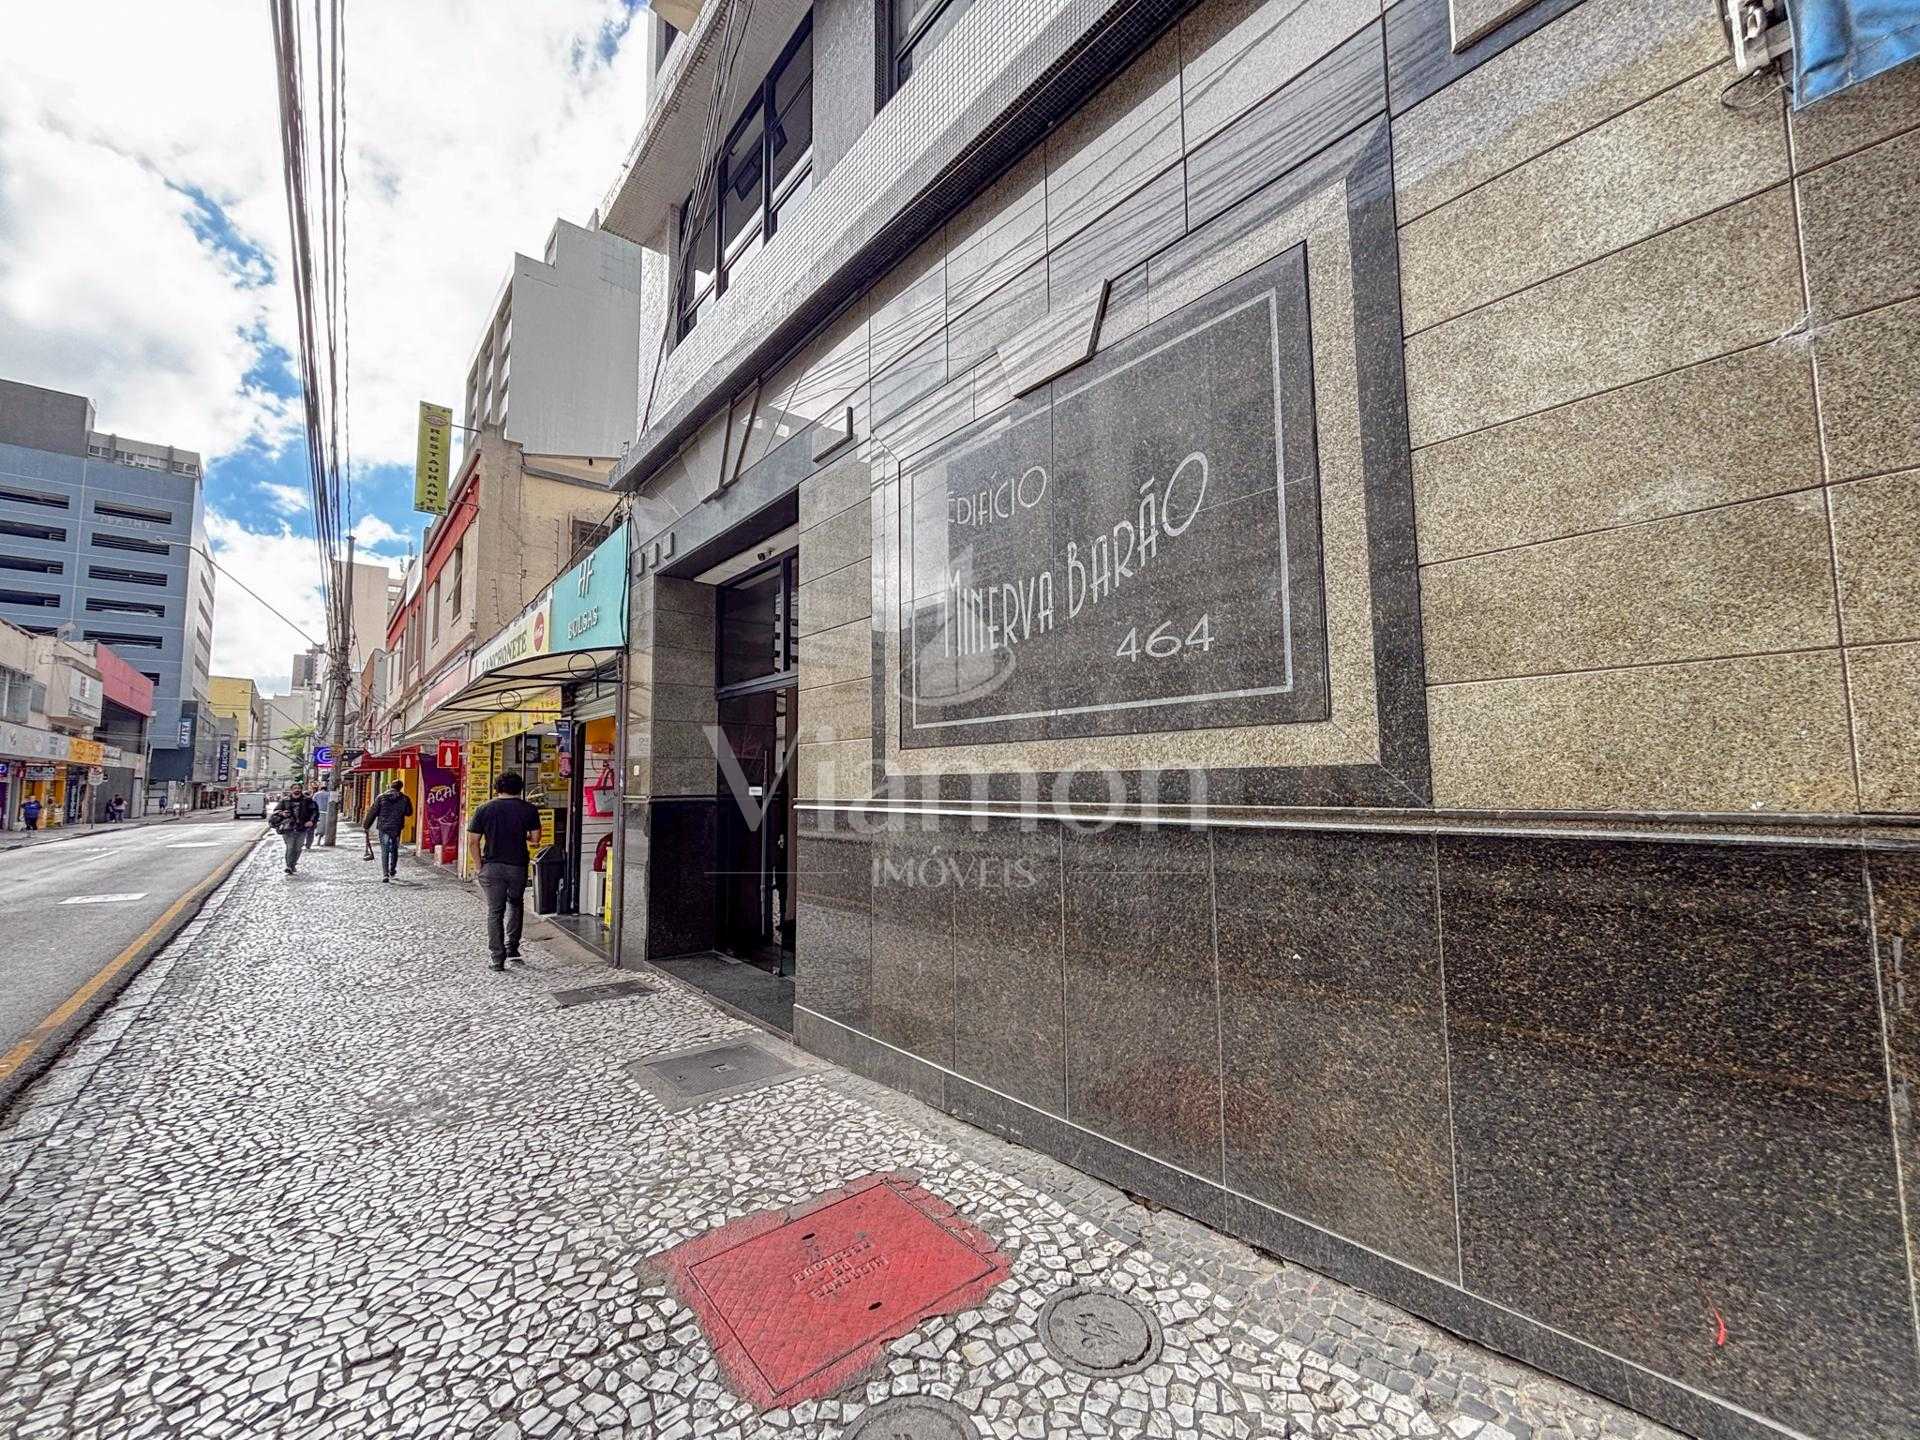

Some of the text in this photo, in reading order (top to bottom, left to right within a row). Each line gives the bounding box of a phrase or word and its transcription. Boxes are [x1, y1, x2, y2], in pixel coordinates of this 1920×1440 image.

[946, 465, 1046, 527] EDIFÍCIO
[944, 451, 1208, 657] MINERVA BARÃO
[568, 605, 598, 640] BOLSAS
[1116, 613, 1215, 662] 464
